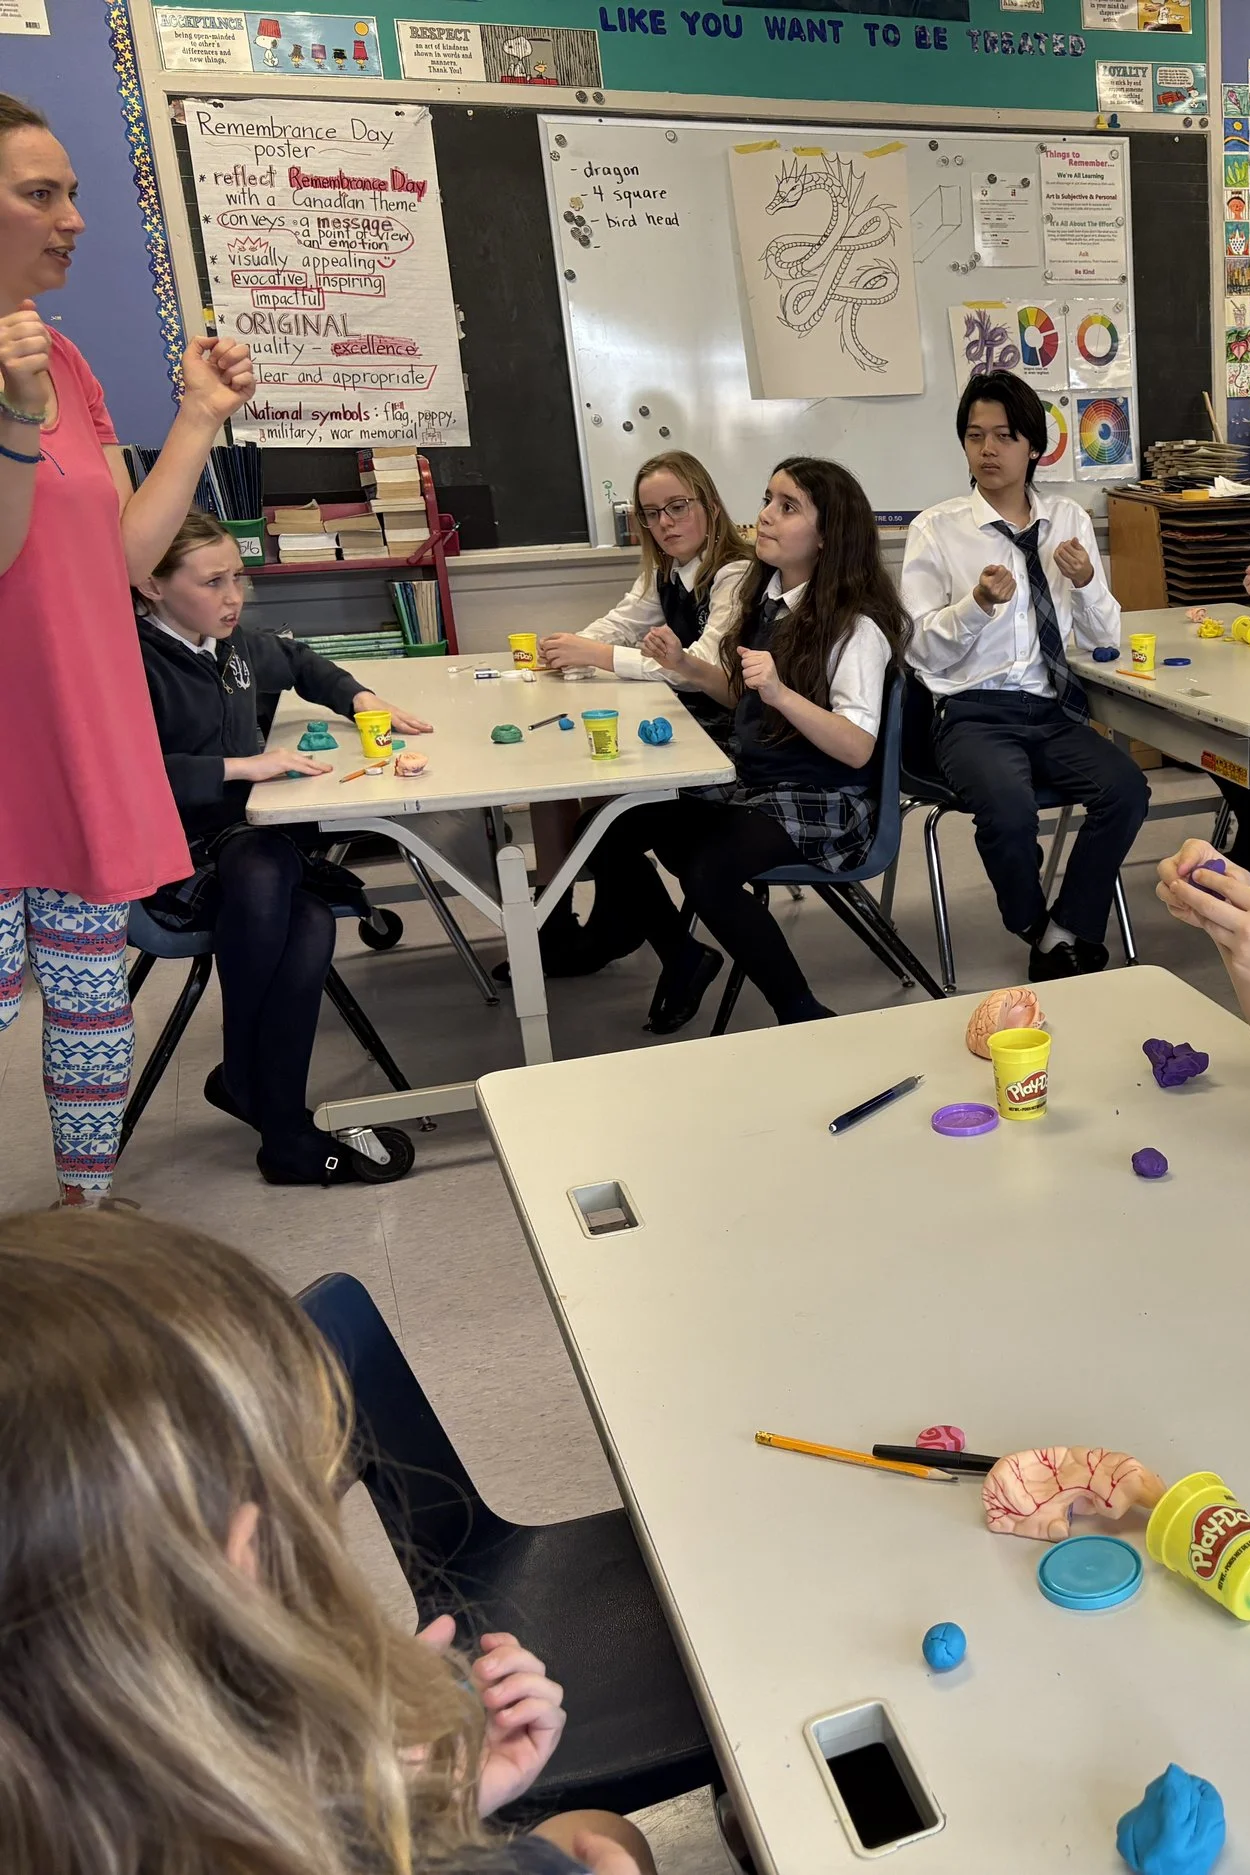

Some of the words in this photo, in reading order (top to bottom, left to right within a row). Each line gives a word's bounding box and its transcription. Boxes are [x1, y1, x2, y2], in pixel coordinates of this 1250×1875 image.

[160, 15, 244, 30] ACCEPTANCE
[599, 7, 667, 35] LIKE
[680, 11, 742, 38] YOU
[764, 16, 844, 44] WANT
[863, 23, 900, 47] TO
[915, 25, 948, 50] BE
[966, 28, 1086, 57] TREATED
[174, 31, 192, 39] being
[194, 32, 236, 40] open-minded
[409, 26, 471, 41] RESPECT
[205, 56, 226, 64] things.
[449, 66, 462, 74] You!
[196, 111, 336, 139] Remembrance
[350, 118, 394, 150] Day
[254, 140, 316, 165] poster
[1046, 150, 1070, 160] Things
[1069, 159, 1114, 167] Remember...
[214, 165, 276, 188] reflect
[288, 166, 388, 190] Remembrance
[391, 167, 426, 201] Day
[584, 162, 639, 184] dragon
[226, 188, 260, 206] with
[267, 195, 276, 206] a
[292, 190, 365, 210] Canadian
[370, 194, 418, 212] theme
[593, 185, 604, 201] 4
[613, 189, 667, 208] square
[221, 213, 285, 233] conveys
[301, 217, 310, 228] a
[317, 217, 392, 236] message
[607, 213, 637, 228] bird
[645, 212, 680, 226] head
[302, 228, 310, 238] a
[318, 227, 350, 246] point
[356, 229, 369, 241] of
[377, 230, 410, 242] view
[303, 238, 320, 248] an
[328, 238, 388, 250] emotion
[228, 247, 288, 272] visually
[302, 252, 376, 277] appealing
[318, 273, 382, 294] inspiring
[256, 288, 322, 310] impactful
[235, 312, 362, 338] ORIGINAL
[332, 340, 419, 357] excellence
[256, 366, 288, 383] lear
[298, 366, 322, 382] and
[332, 369, 428, 390] appropriate
[244, 402, 302, 422] National
[266, 423, 322, 444] military,
[330, 428, 354, 440] war
[360, 424, 418, 440] memorial
[1007, 1074, 1048, 1100] Play-D
